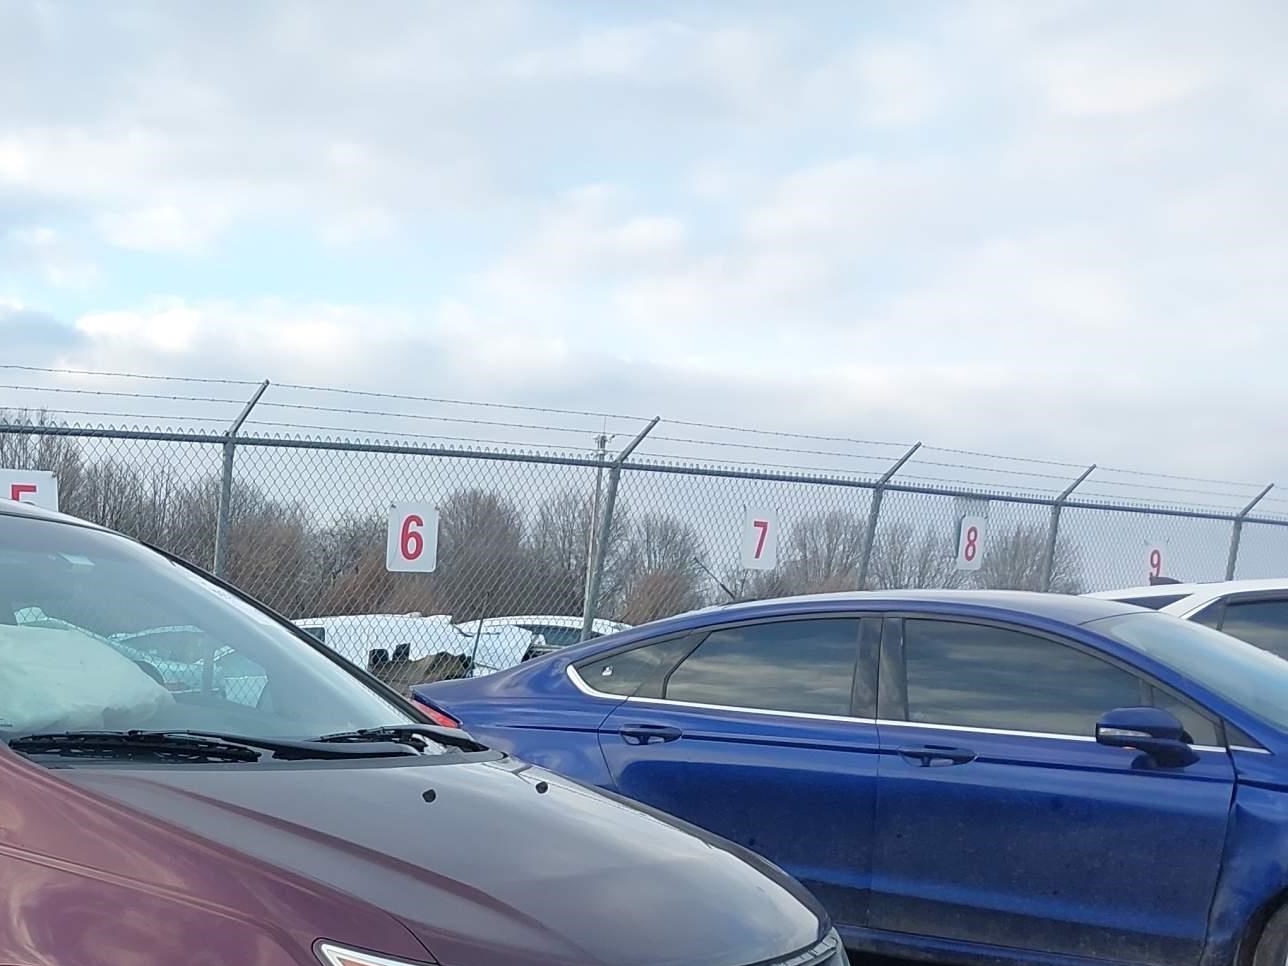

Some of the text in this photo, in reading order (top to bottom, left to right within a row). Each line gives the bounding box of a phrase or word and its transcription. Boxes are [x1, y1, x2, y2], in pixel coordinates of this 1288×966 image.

[400, 514, 424, 561] 6
[753, 520, 769, 559] 7
[964, 526, 978, 562] 8
[1149, 548, 1161, 577] 9
